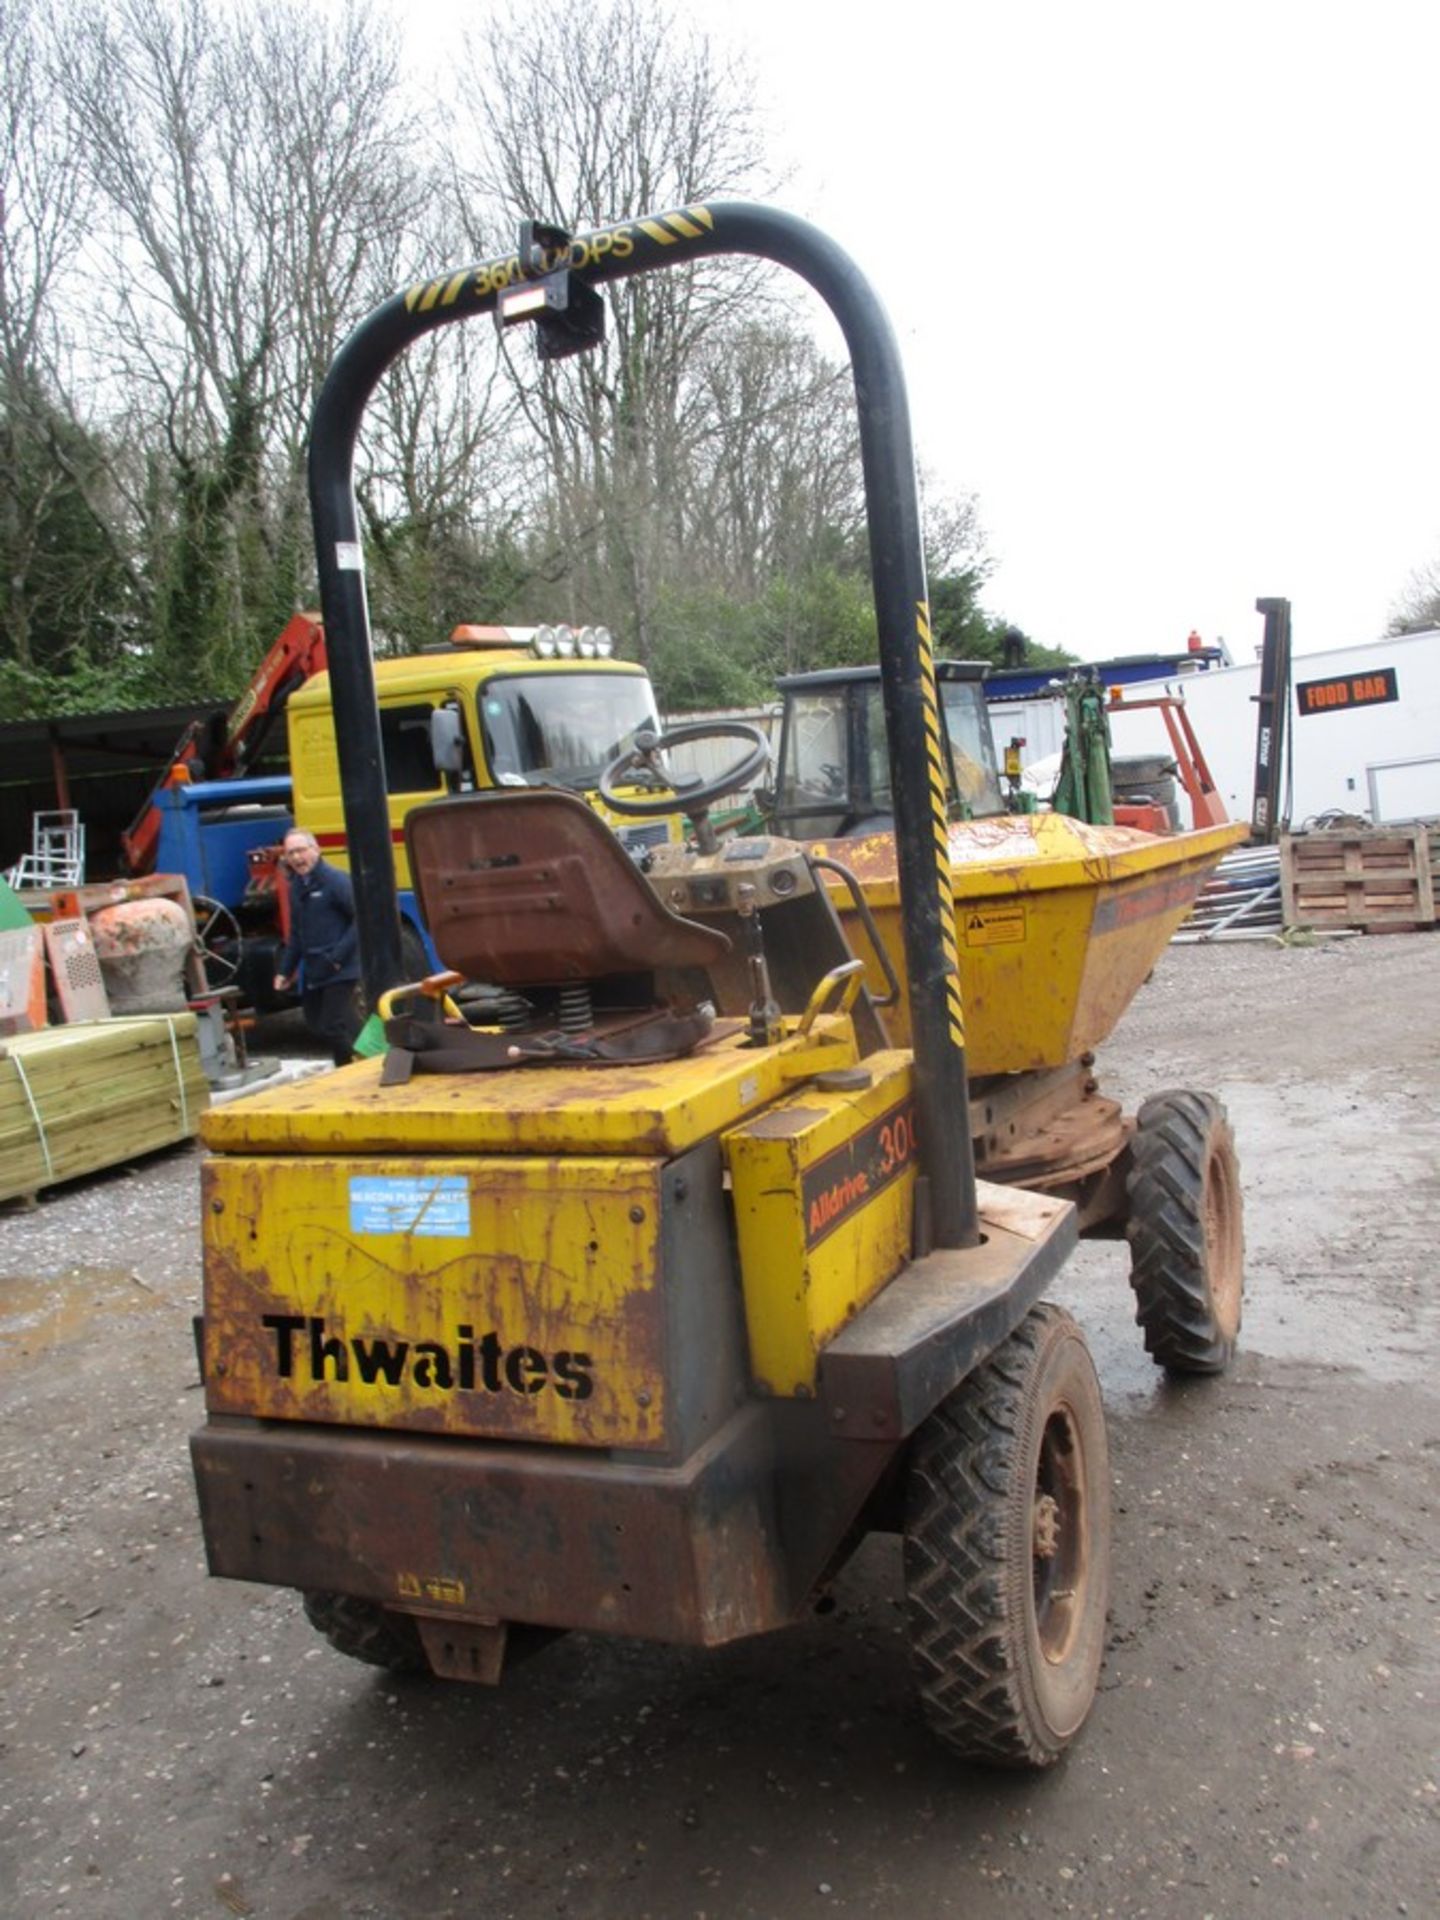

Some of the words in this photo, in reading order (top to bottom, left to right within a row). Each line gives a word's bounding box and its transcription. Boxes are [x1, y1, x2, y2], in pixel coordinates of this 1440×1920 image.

[548, 226, 634, 272] OPS
[1306, 682, 1348, 709] FOOD
[1352, 676, 1387, 701] BAR
[810, 1171, 869, 1235] Alldrive
[263, 1315, 594, 1400] Thwaites
